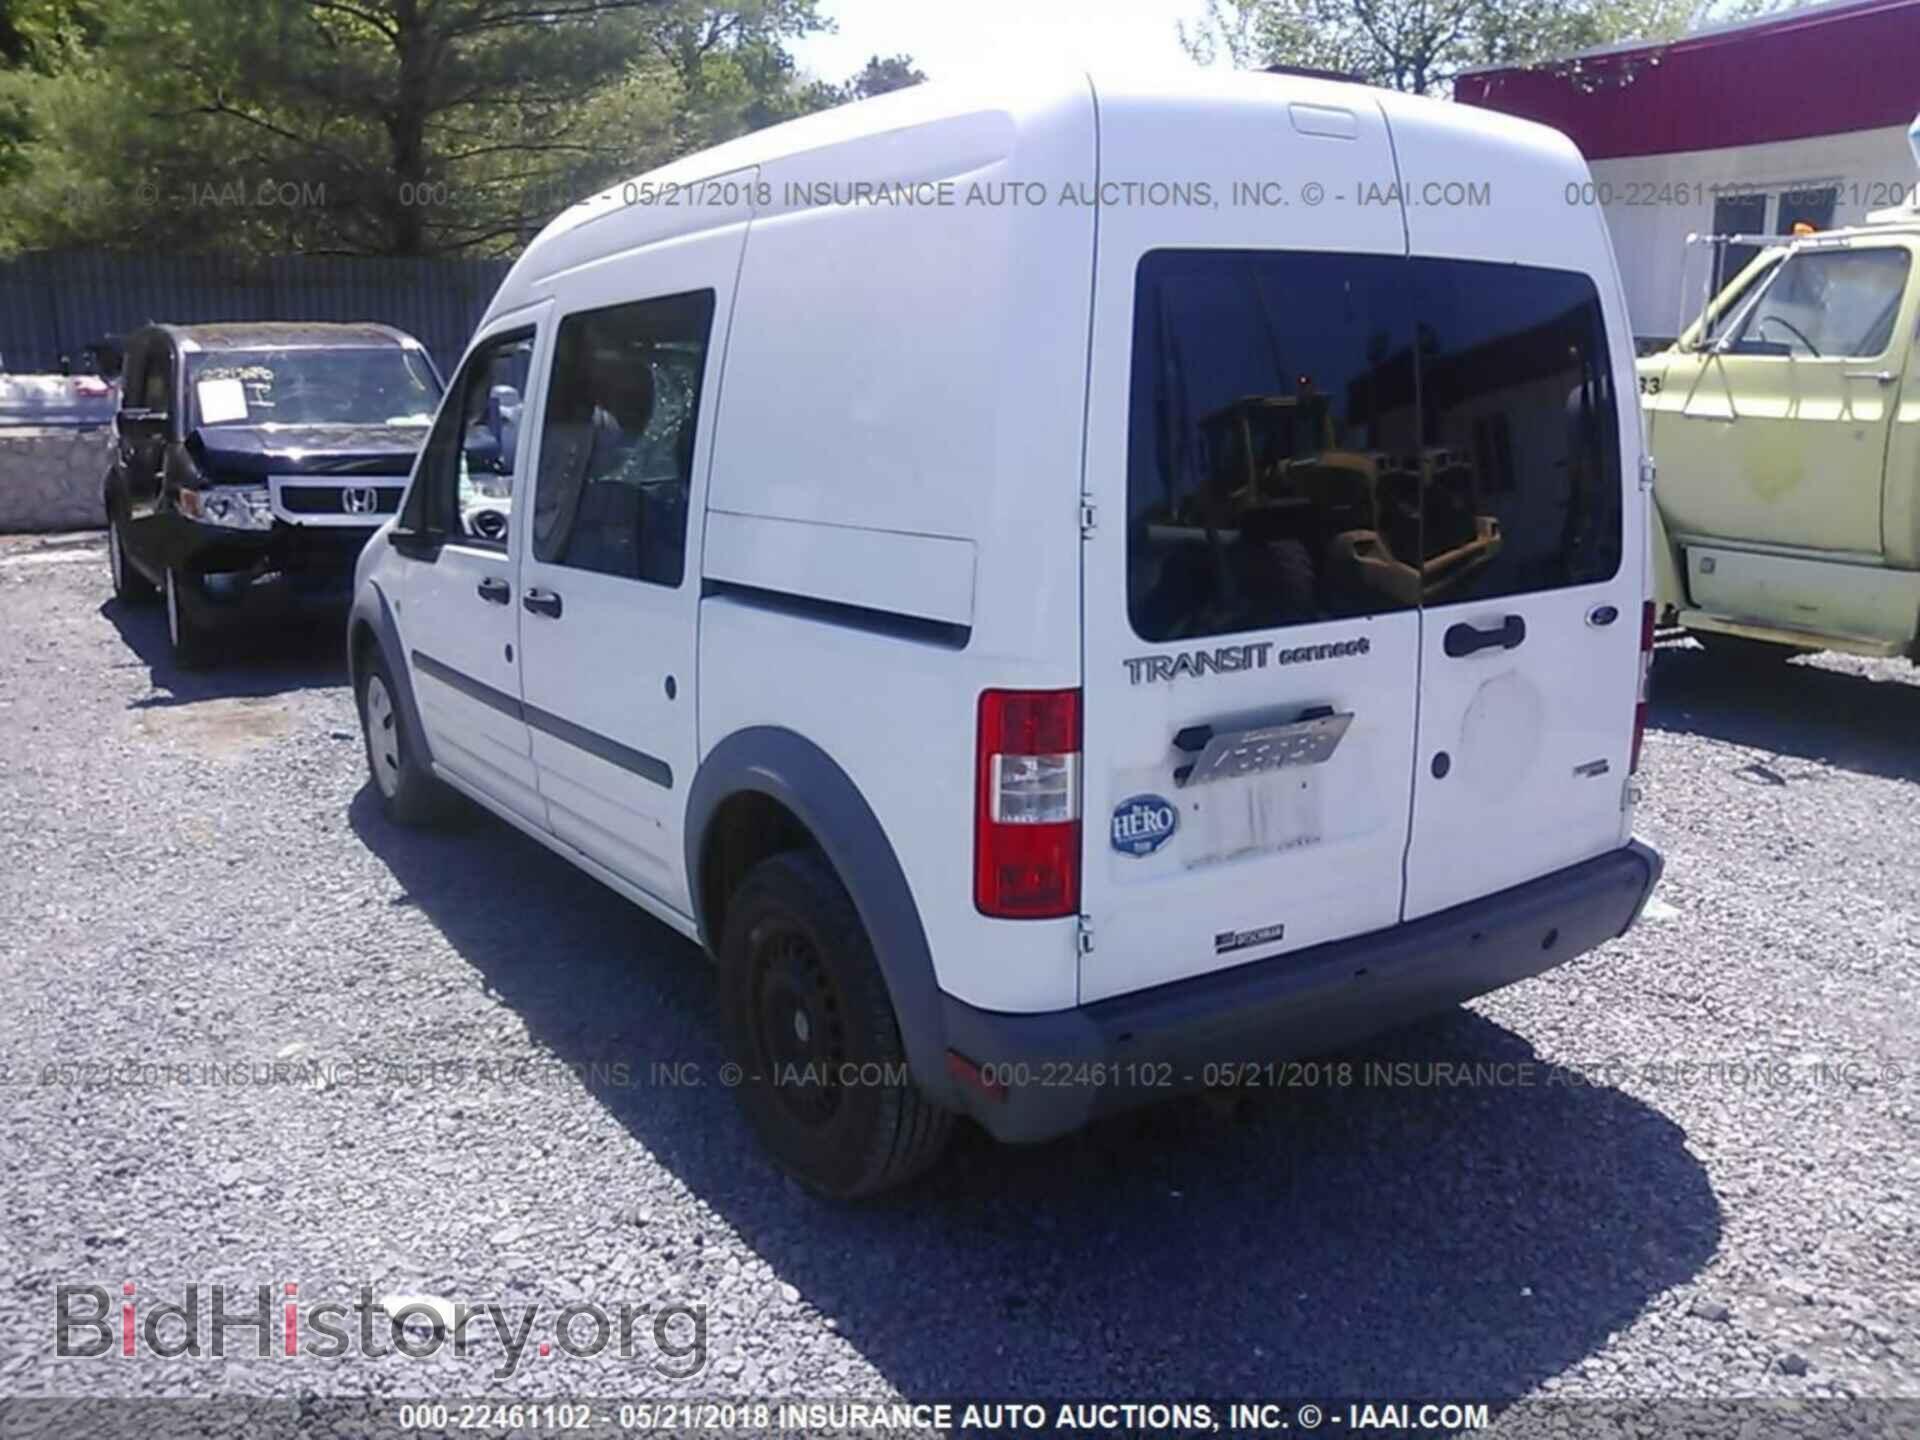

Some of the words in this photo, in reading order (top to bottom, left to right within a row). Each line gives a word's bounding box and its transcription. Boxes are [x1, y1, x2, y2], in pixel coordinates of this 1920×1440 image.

[1123, 642, 1273, 685] TRANSIT
[1278, 637, 1370, 665] connect
[1114, 807, 1173, 837] HERO
